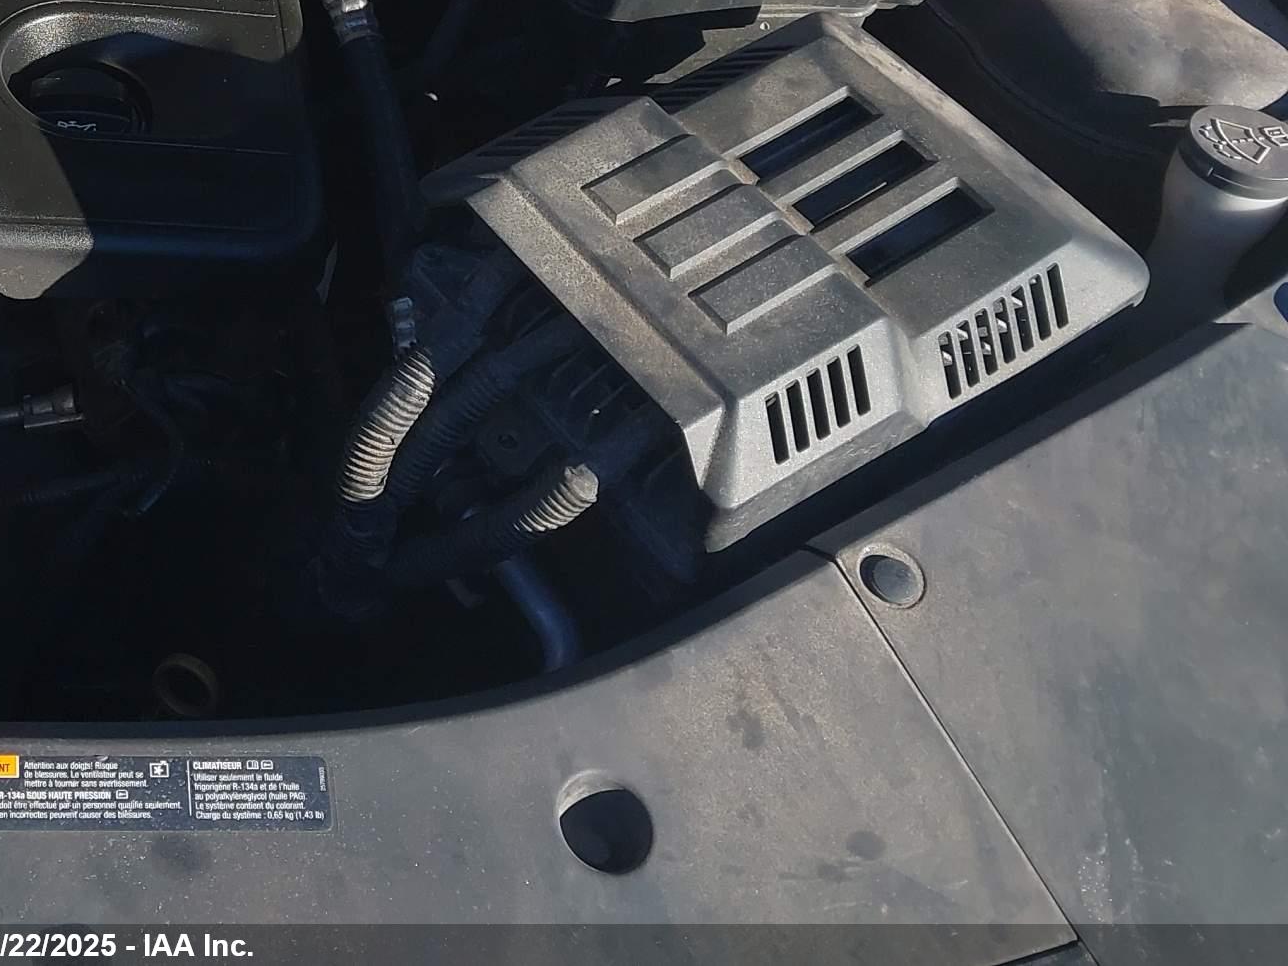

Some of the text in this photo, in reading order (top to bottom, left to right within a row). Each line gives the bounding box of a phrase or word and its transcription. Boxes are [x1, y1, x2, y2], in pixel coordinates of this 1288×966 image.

[24, 762, 54, 770] Attention
[70, 762, 93, 771] doigts!
[95, 762, 118, 771] Risque
[193, 762, 242, 770] CLIMATISEUR
[99, 780, 149, 788] avertissement.
[0, 791, 25, 799] R-134a
[27, 792, 47, 800] SOUS
[49, 792, 73, 800] HAUTE
[74, 792, 111, 800] PRESSION
[269, 793, 288, 801] (huile
[0, 801, 12, 809] doit
[83, 802, 116, 810] personnel
[195, 802, 204, 810] Le
[236, 802, 264, 810] contient
[265, 802, 275, 810] du
[50, 811, 77, 820] peuvent
[104, 811, 116, 819] des
[196, 812, 221, 820] Charge
[285, 812, 294, 820] kg
[315, 812, 324, 820] lb)
